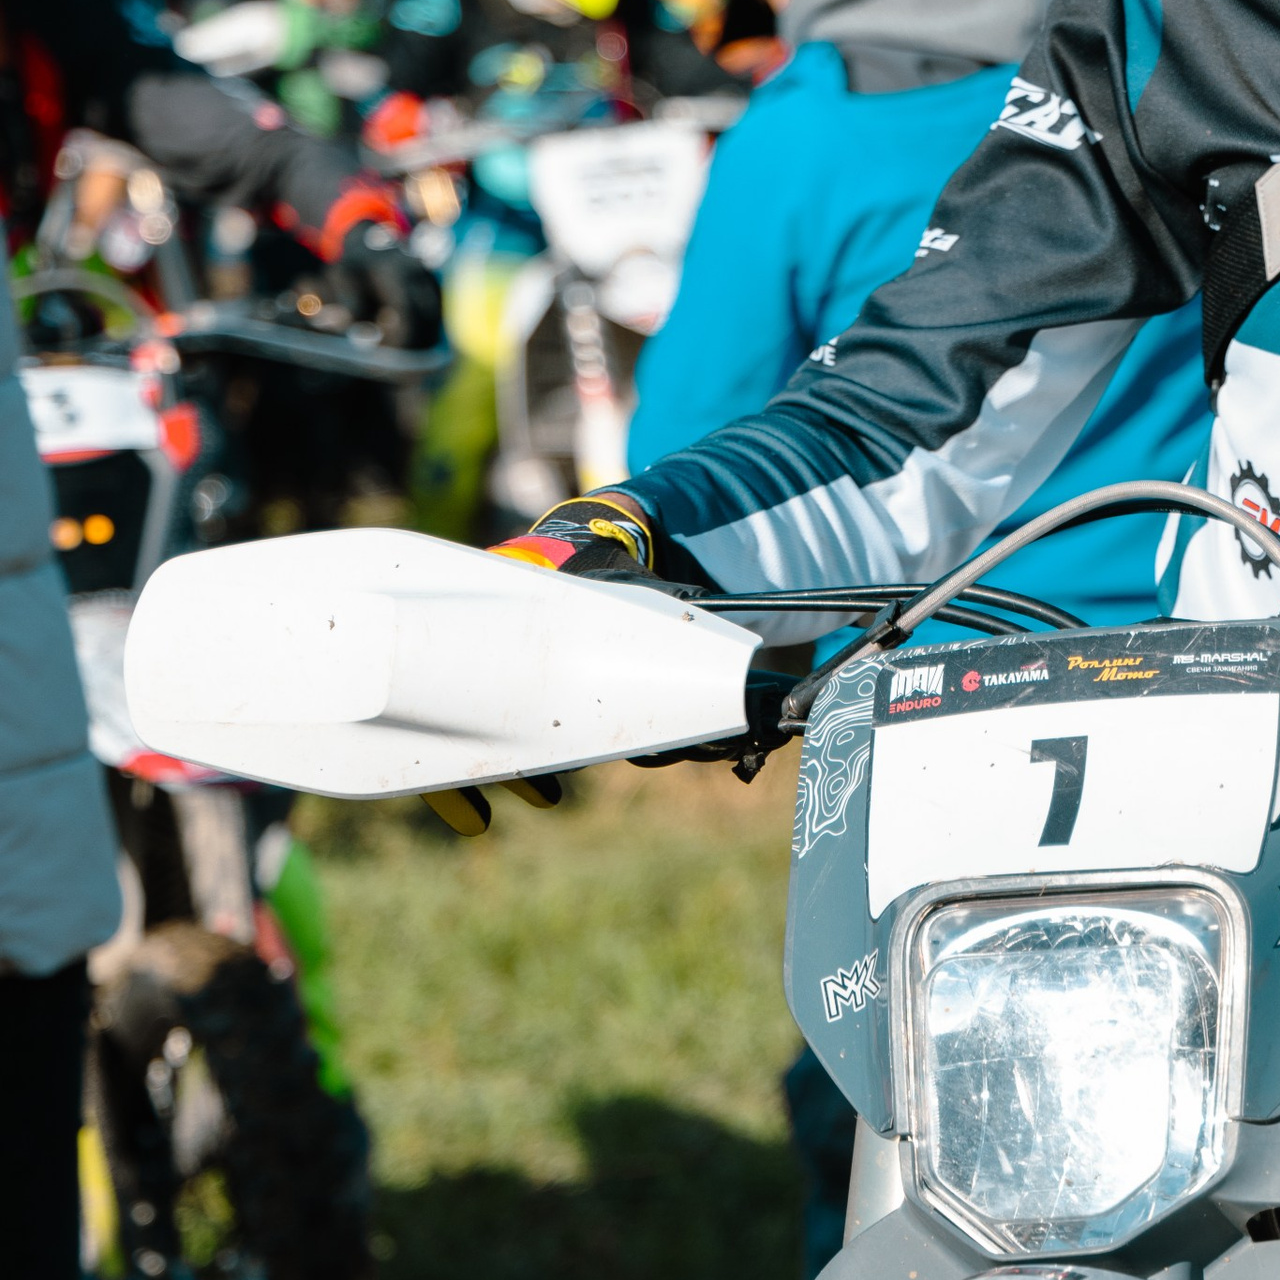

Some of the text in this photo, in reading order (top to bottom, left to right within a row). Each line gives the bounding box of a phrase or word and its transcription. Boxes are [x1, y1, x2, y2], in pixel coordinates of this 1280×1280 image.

[1186, 664, 1259, 674] СВЕЧИ ЗАЖИГАНИЯ
[983, 669, 1049, 687] TAKAYAMA
[889, 697, 942, 714] ENDURO
